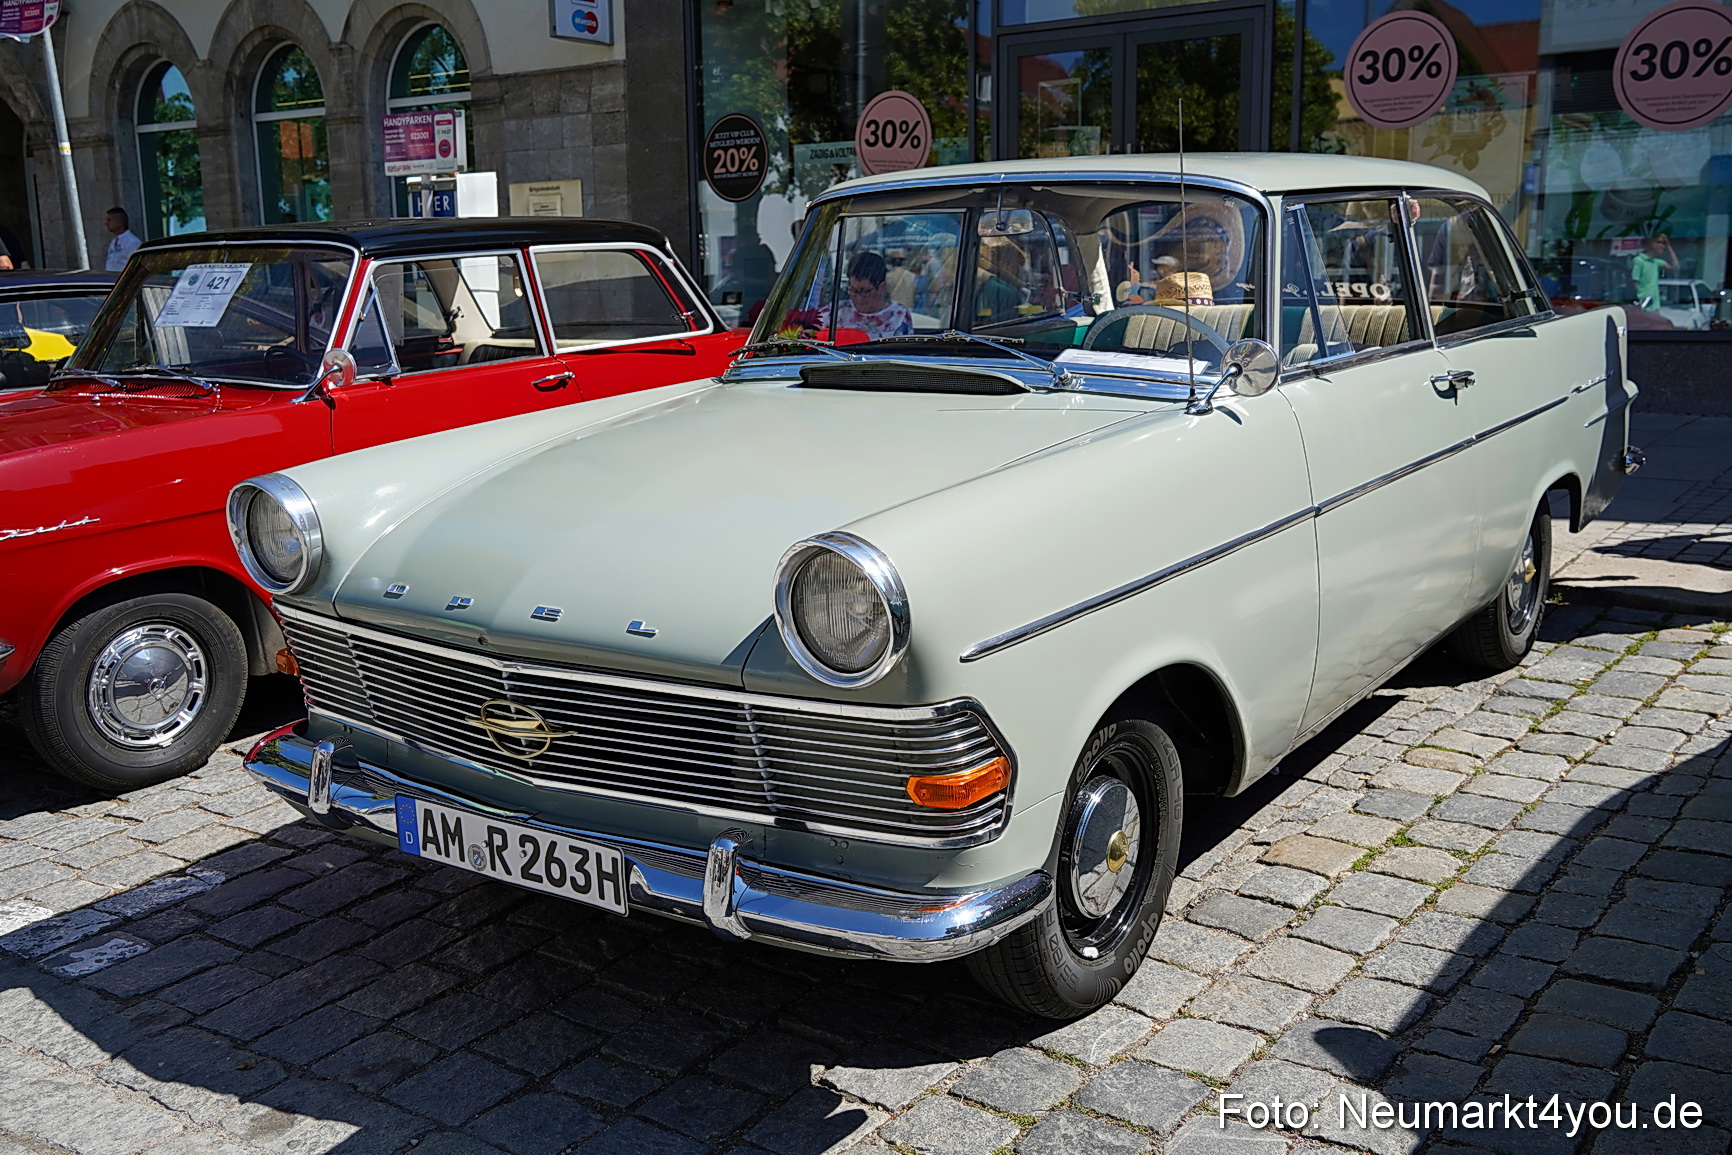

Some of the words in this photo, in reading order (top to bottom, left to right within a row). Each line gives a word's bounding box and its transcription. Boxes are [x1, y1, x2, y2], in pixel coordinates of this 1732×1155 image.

[1357, 42, 1442, 85] 30%
[1629, 36, 1732, 82] 30%
[383, 115, 432, 127] HANDYPARKEN
[740, 129, 755, 137] CLUB
[864, 119, 922, 149] 30%
[410, 132, 430, 140] 923001
[709, 139, 735, 148] MITGLIED
[713, 146, 759, 174] 20%
[417, 195, 450, 213] HER
[206, 276, 231, 290] 421
[384, 582, 659, 636] OPEL
[1076, 722, 1117, 783] apollo
[405, 831, 414, 844] D
[422, 808, 466, 863] AM
[486, 825, 513, 877] R
[519, 834, 622, 907] 263H
[1123, 912, 1160, 976] apollo
